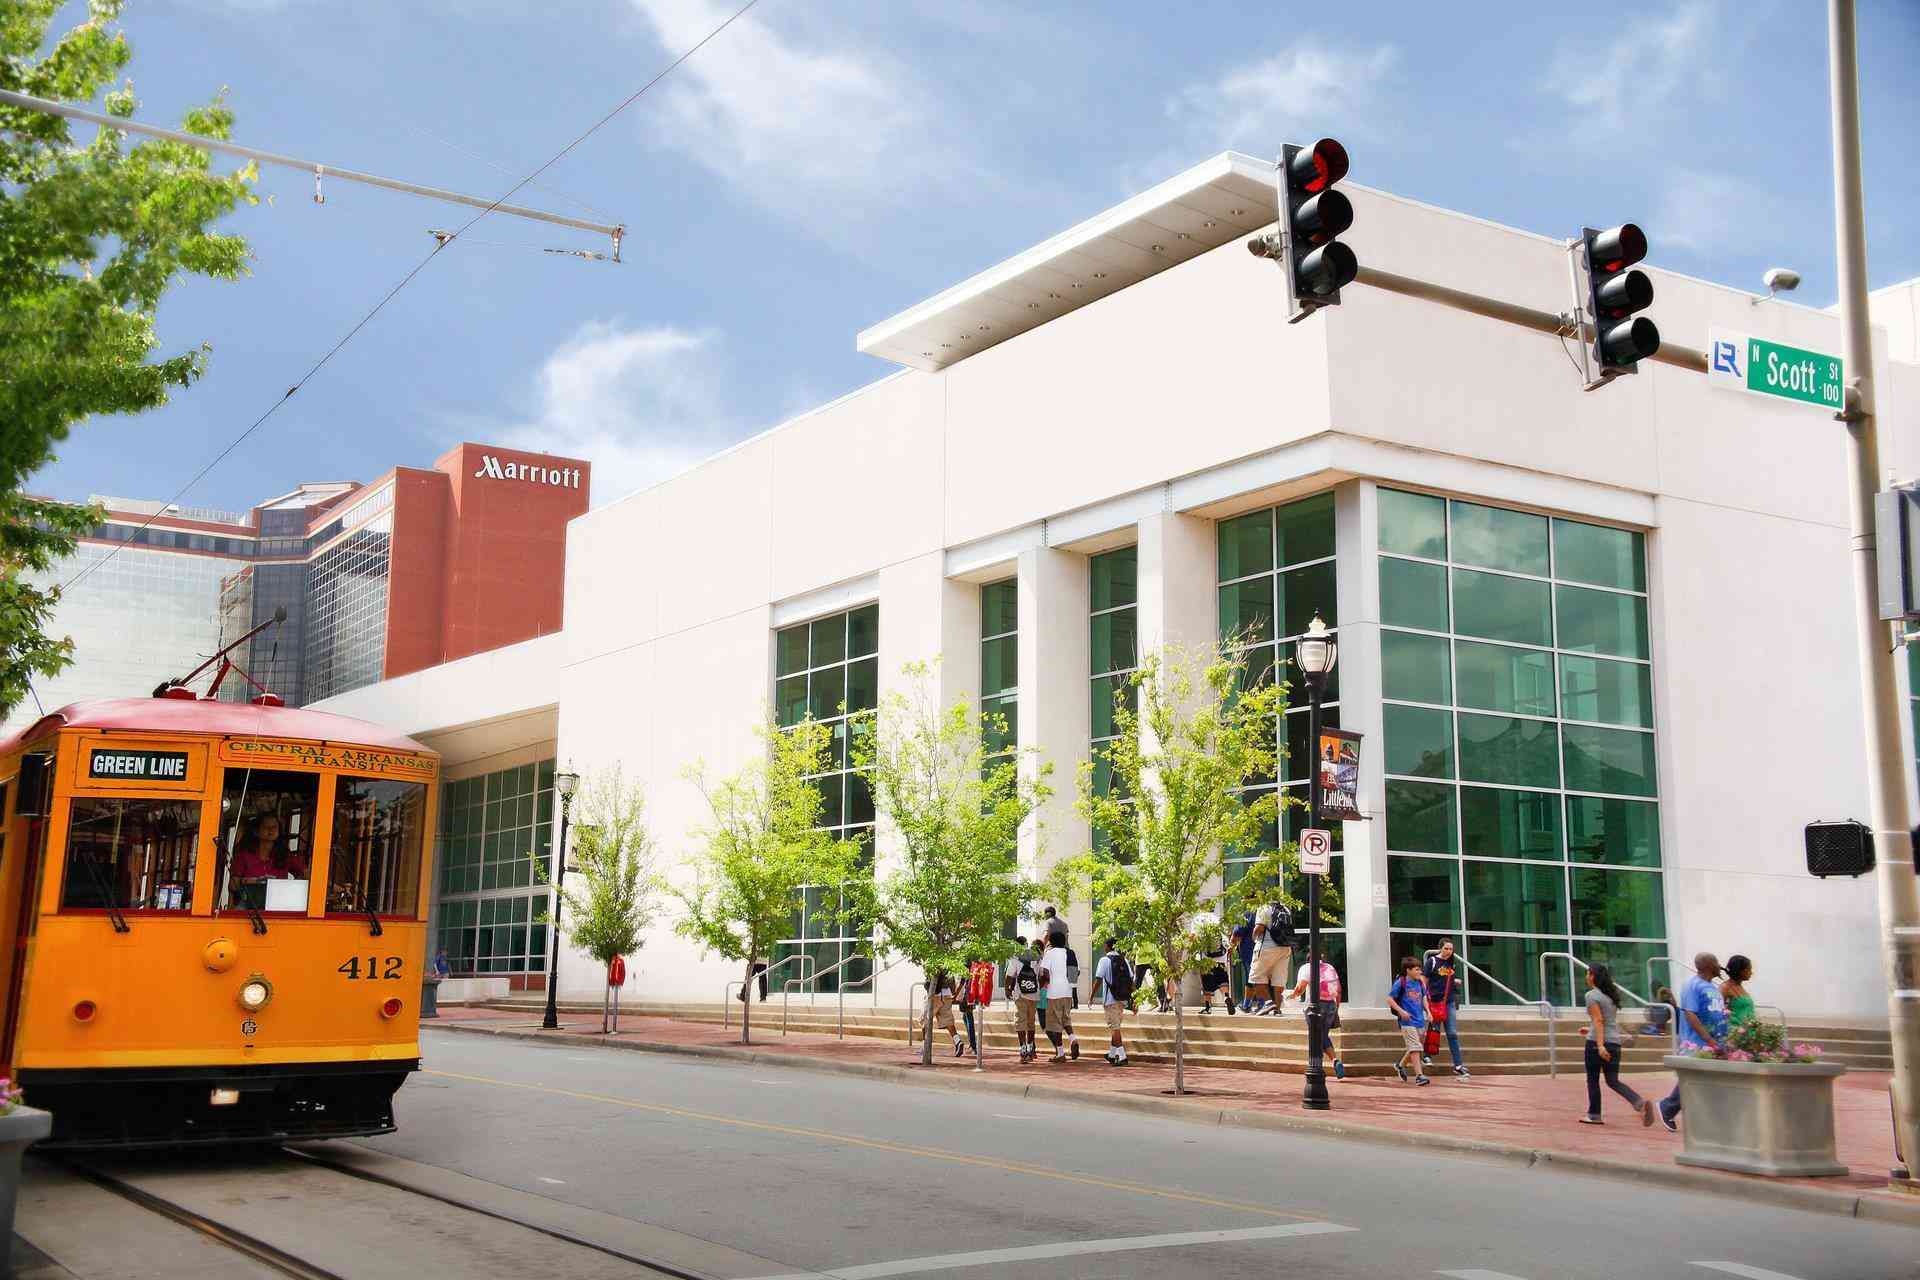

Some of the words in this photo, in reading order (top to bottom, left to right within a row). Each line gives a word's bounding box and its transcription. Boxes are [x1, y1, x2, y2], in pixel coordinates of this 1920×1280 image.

[1752, 343, 1760, 362] N
[1766, 351, 1816, 394] Scott
[1828, 362, 1839, 380] St
[1823, 382, 1839, 402] 100
[475, 455, 580, 489] Marriott
[93, 755, 146, 775] GREEN
[150, 757, 185, 776] LINE
[228, 740, 332, 757] CENTRAL
[341, 750, 434, 770] ARKANSAS
[301, 755, 388, 772] TRANSIT
[337, 956, 403, 980] 412
